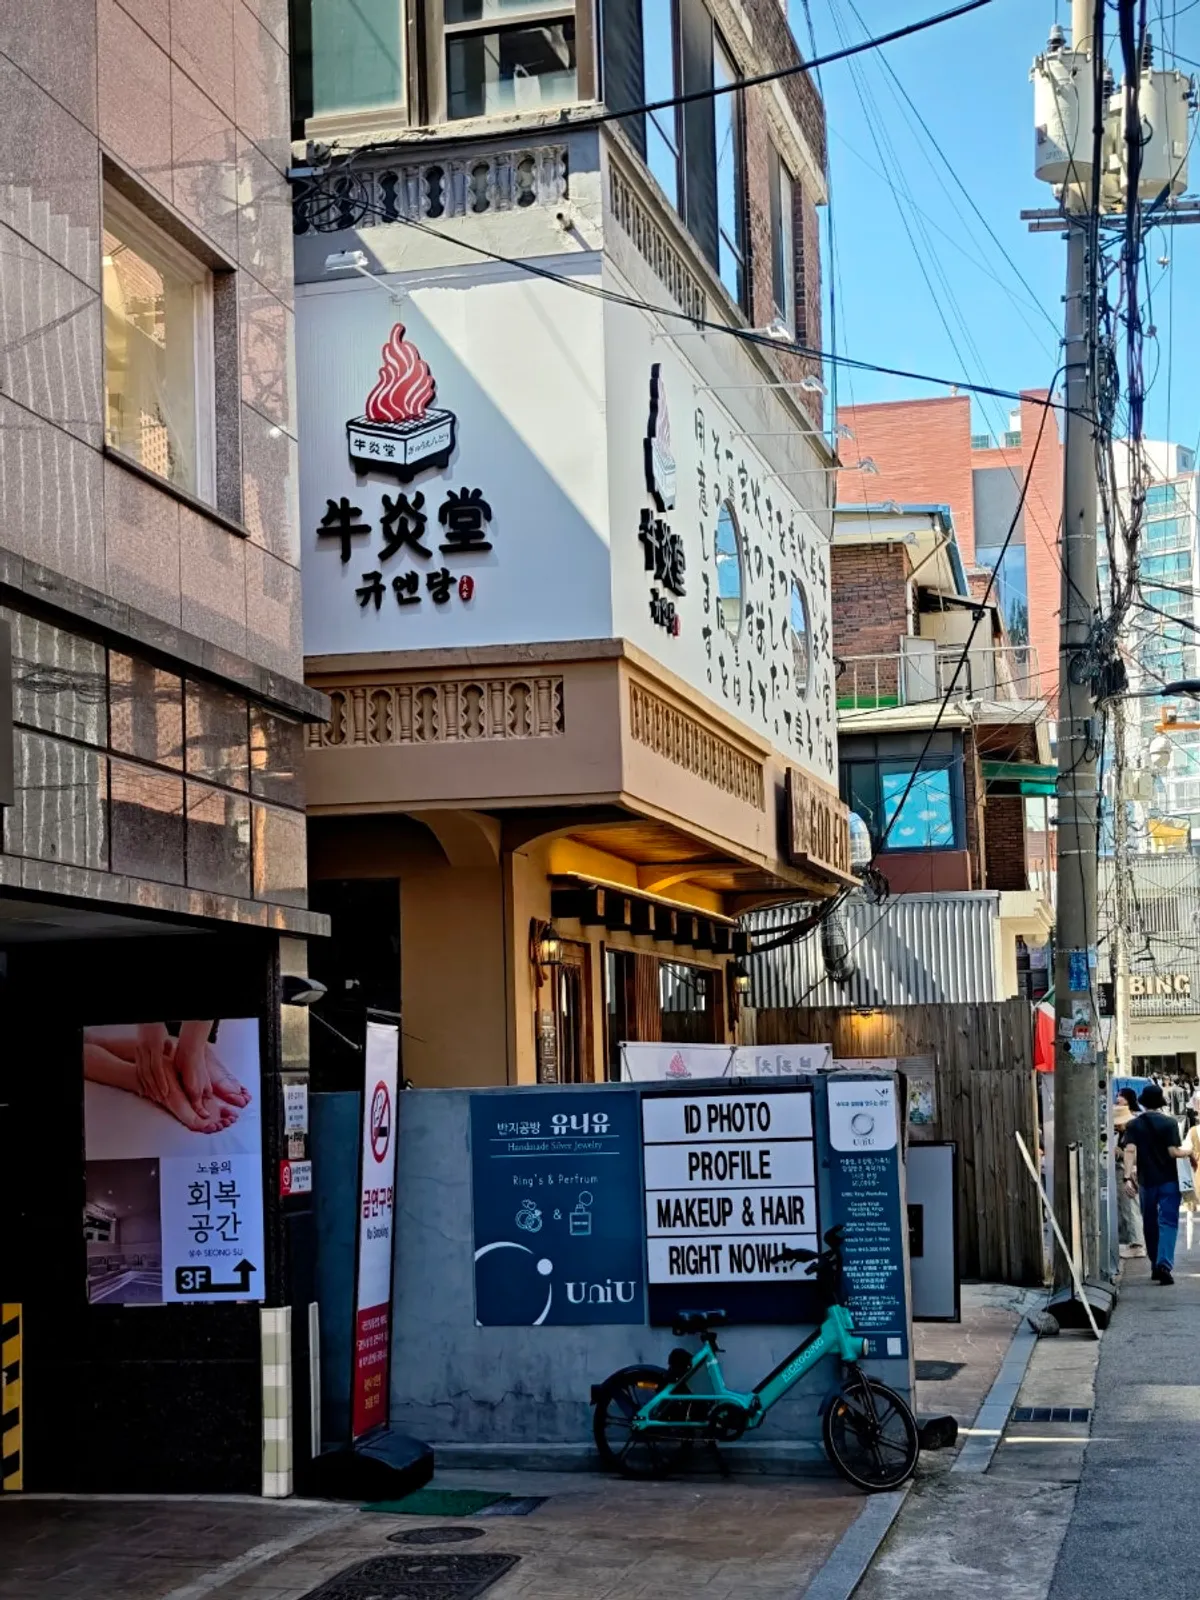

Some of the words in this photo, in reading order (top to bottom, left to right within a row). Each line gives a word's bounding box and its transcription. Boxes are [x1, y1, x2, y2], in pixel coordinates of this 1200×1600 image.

[316, 486, 493, 563] 牛炎堂
[638, 508, 687, 597] 牛炎堂
[497, 1121, 541, 1136] 반지공방
[550, 1112, 611, 1135] 유니유
[684, 1104, 700, 1134] ID
[707, 1101, 771, 1133] PHOTO
[508, 1141, 549, 1151] Handmade
[551, 1141, 572, 1150] Silver
[574, 1140, 603, 1151] Jewelry
[513, 1173, 544, 1188] Ring's
[547, 1174, 554, 1185] &
[688, 1150, 772, 1181] PROFILE
[187, 1180, 241, 1211] 회복
[363, 1186, 394, 1218] 금연구역
[188, 1211, 242, 1243] 공간
[553, 1208, 562, 1220] &
[656, 1197, 733, 1228] MAKEUP
[742, 1196, 755, 1227] &
[760, 1195, 805, 1226] HAIR
[668, 1244, 722, 1275] RIGHT
[181, 1270, 207, 1291] 3F
[564, 1278, 637, 1304] UniU
